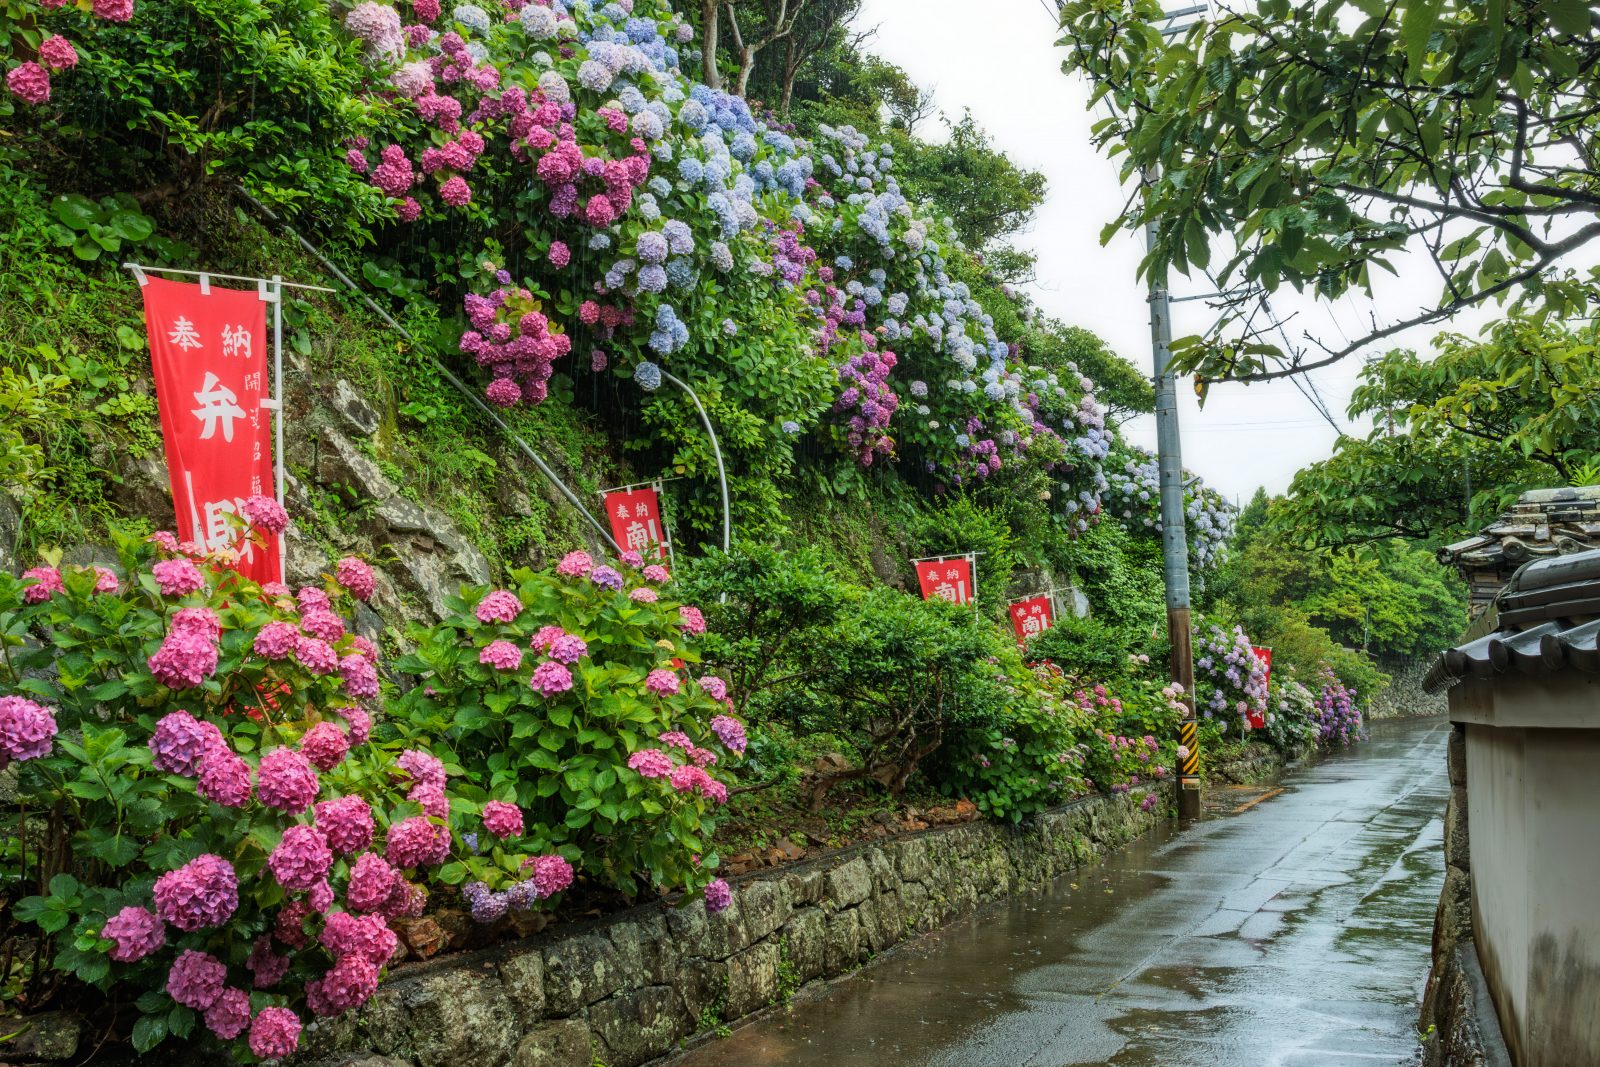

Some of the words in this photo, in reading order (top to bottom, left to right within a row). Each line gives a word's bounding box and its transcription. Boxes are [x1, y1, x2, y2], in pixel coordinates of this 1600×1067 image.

[168, 315, 252, 359] 奉納
[616, 503, 648, 520] 奉納
[926, 569, 959, 582] 奉納
[1016, 605, 1041, 617] 奉納
